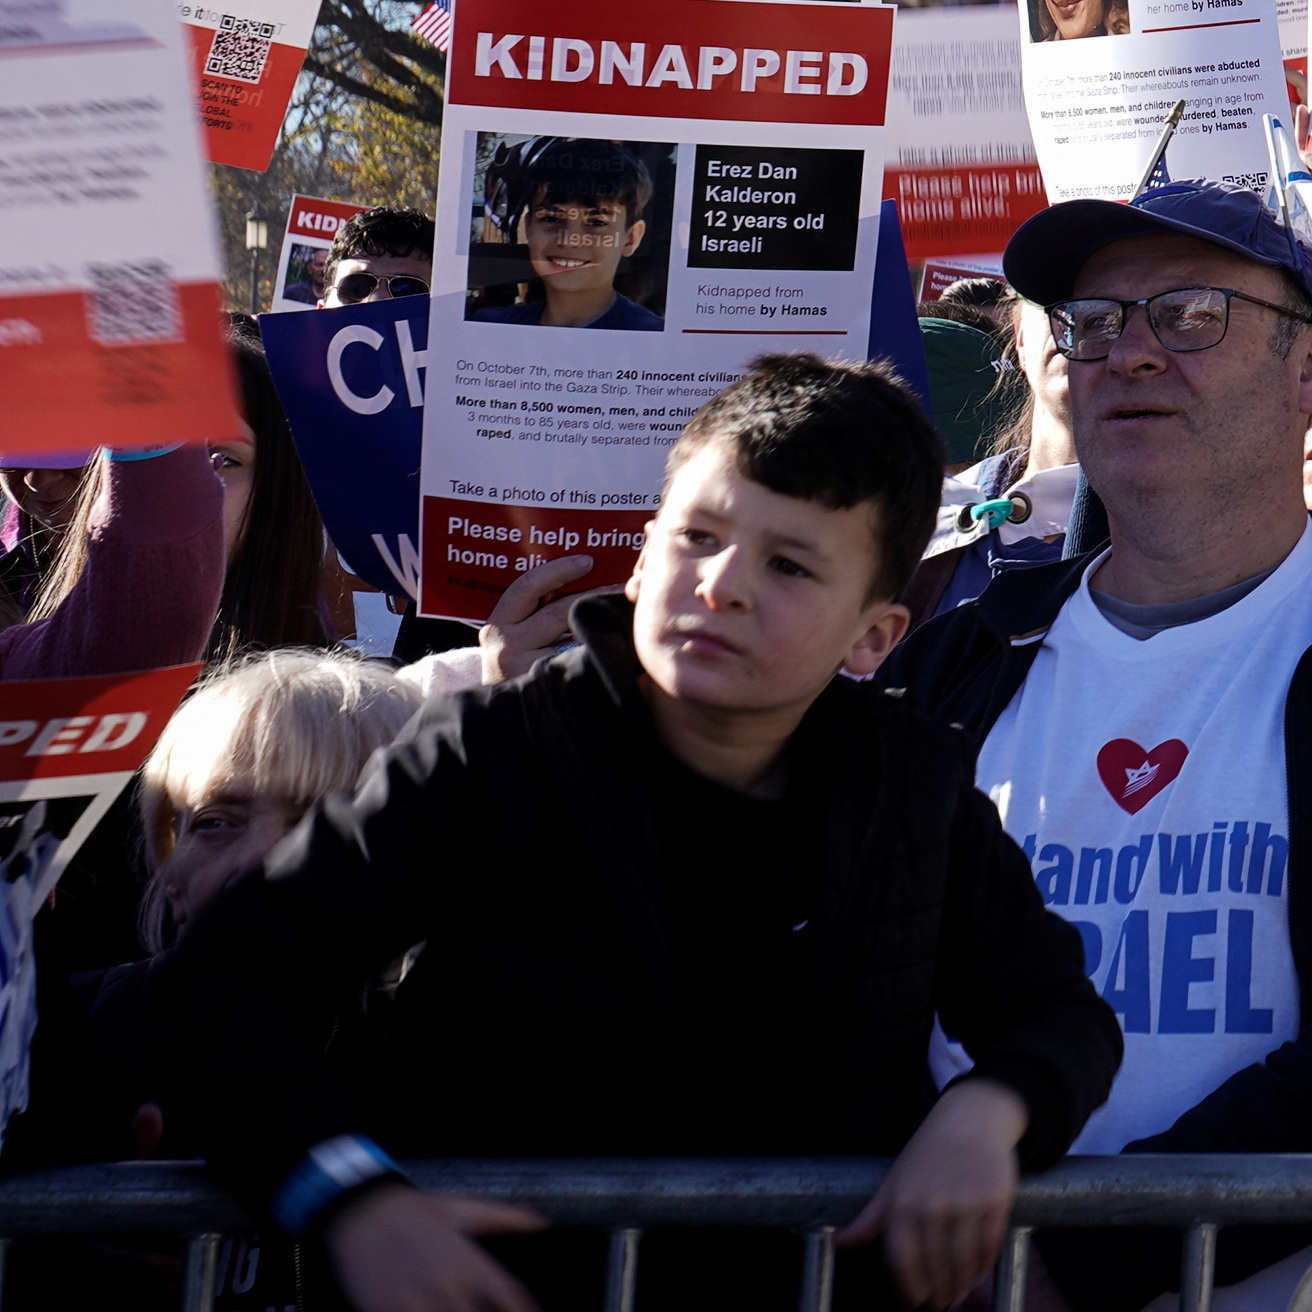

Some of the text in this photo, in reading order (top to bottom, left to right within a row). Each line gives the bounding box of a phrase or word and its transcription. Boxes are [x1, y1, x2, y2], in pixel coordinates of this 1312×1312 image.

[474, 32, 869, 96] KIDNAPPED
[707, 160, 797, 180] Erez Dan
[705, 185, 796, 205] Kalderon
[704, 210, 825, 232] 12 years old
[701, 234, 763, 253] Israeli
[697, 284, 804, 300] Kidnapped from
[696, 304, 828, 318] his home by Hamas
[1158, 821, 1289, 897] with
